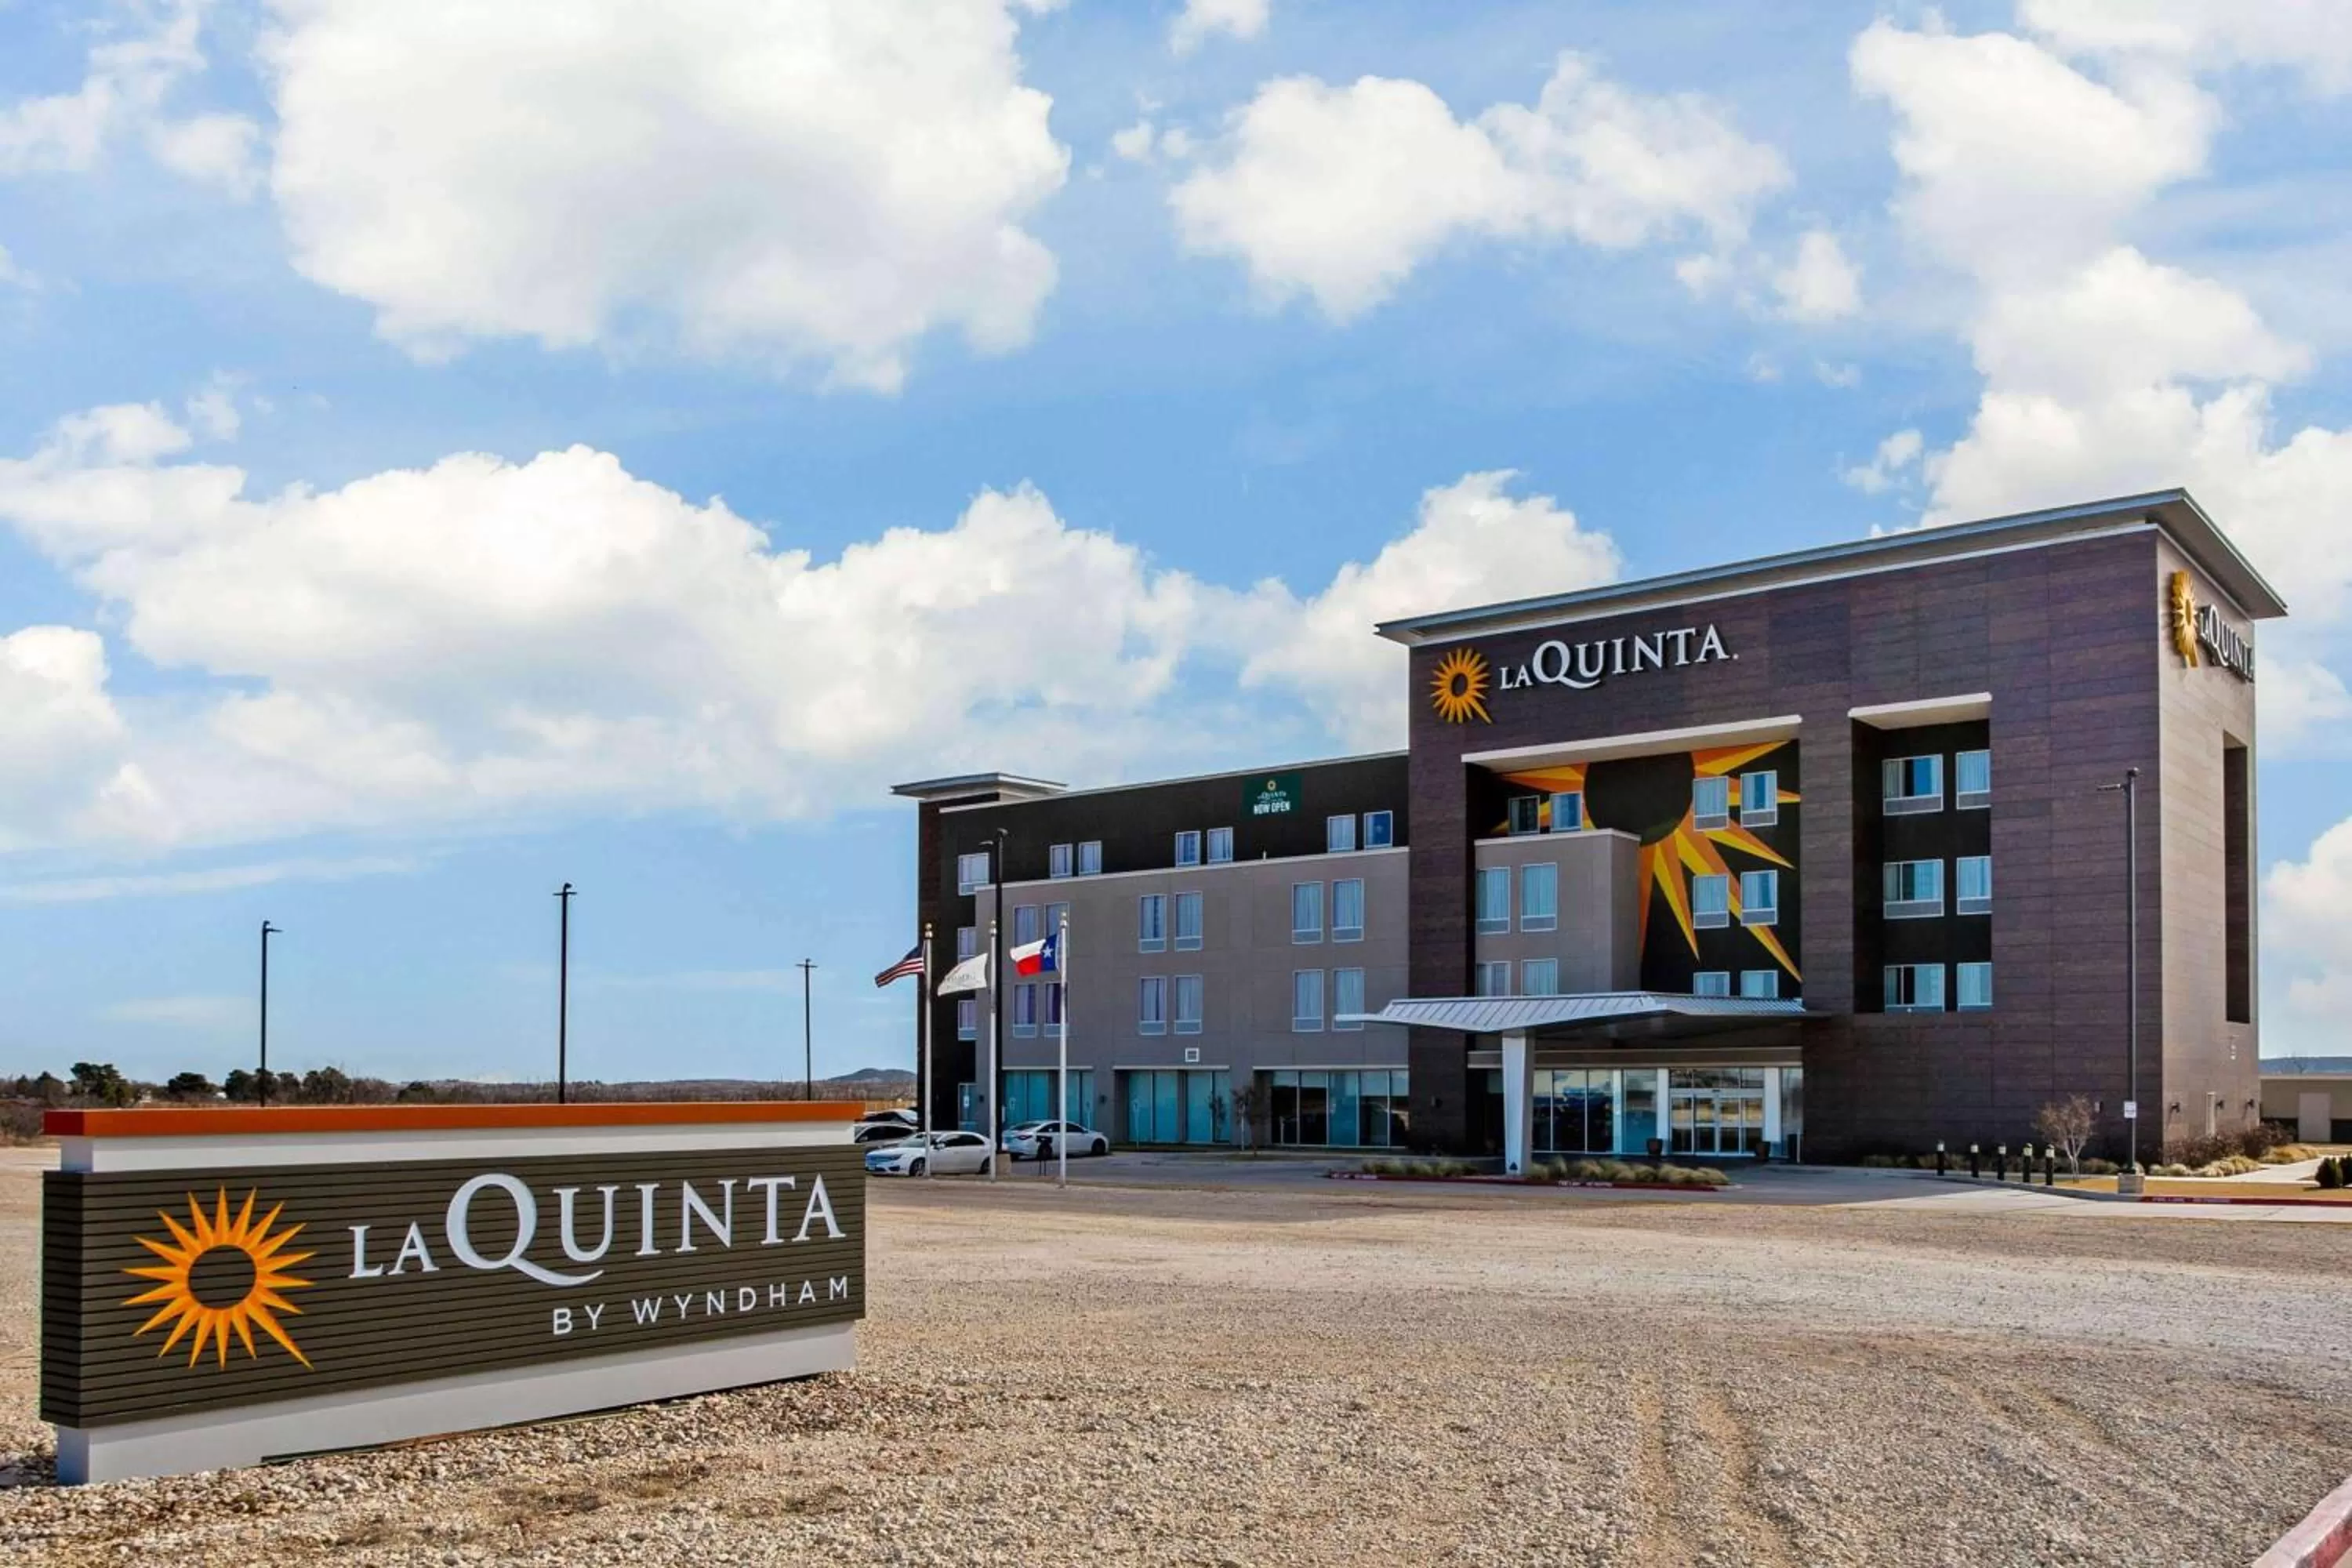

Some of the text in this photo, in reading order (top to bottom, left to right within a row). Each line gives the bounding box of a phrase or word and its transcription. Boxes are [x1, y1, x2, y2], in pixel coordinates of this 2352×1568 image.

[2209, 604, 2255, 679] QUINT
[1499, 664, 1534, 690] LA
[1271, 801, 1290, 813] OPEN
[349, 1173, 847, 1286] LA QUINTA
[553, 1276, 848, 1335] BY WYNDHAM
